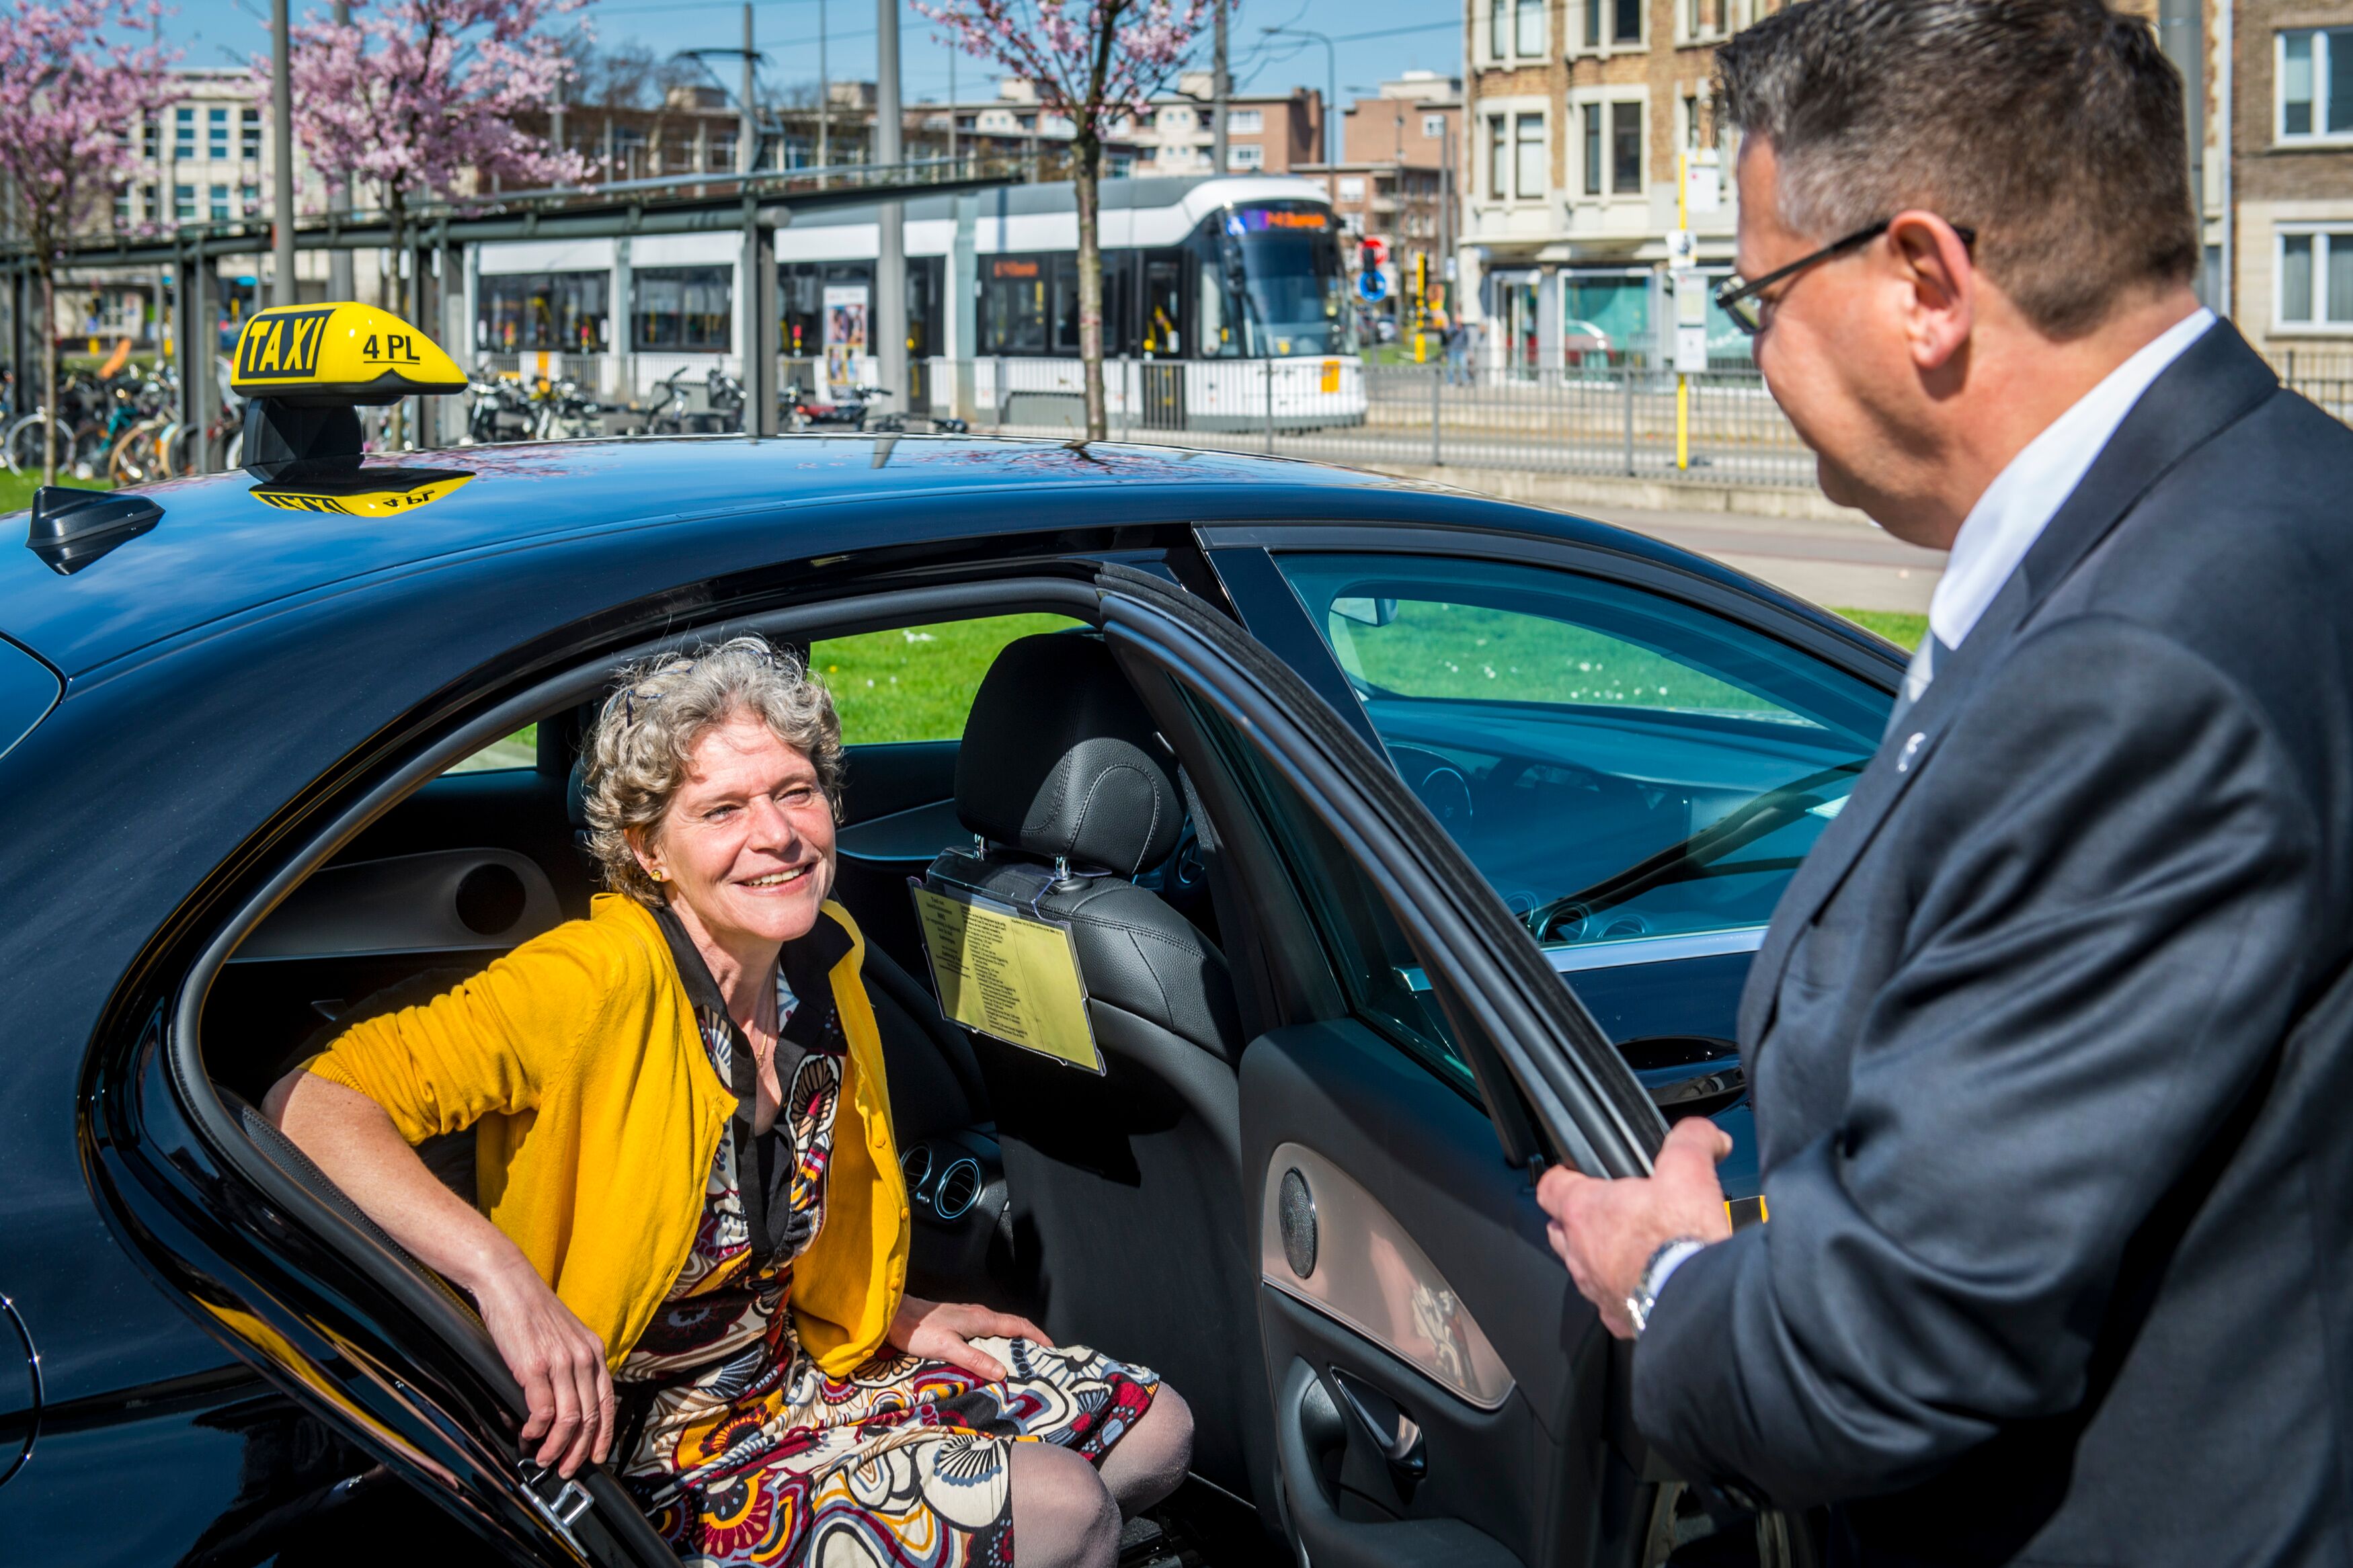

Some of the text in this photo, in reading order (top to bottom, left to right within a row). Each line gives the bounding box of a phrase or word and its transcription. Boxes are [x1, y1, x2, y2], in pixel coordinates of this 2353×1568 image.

[247, 317, 325, 372] TAXI
[363, 334, 420, 361] 4 PL
